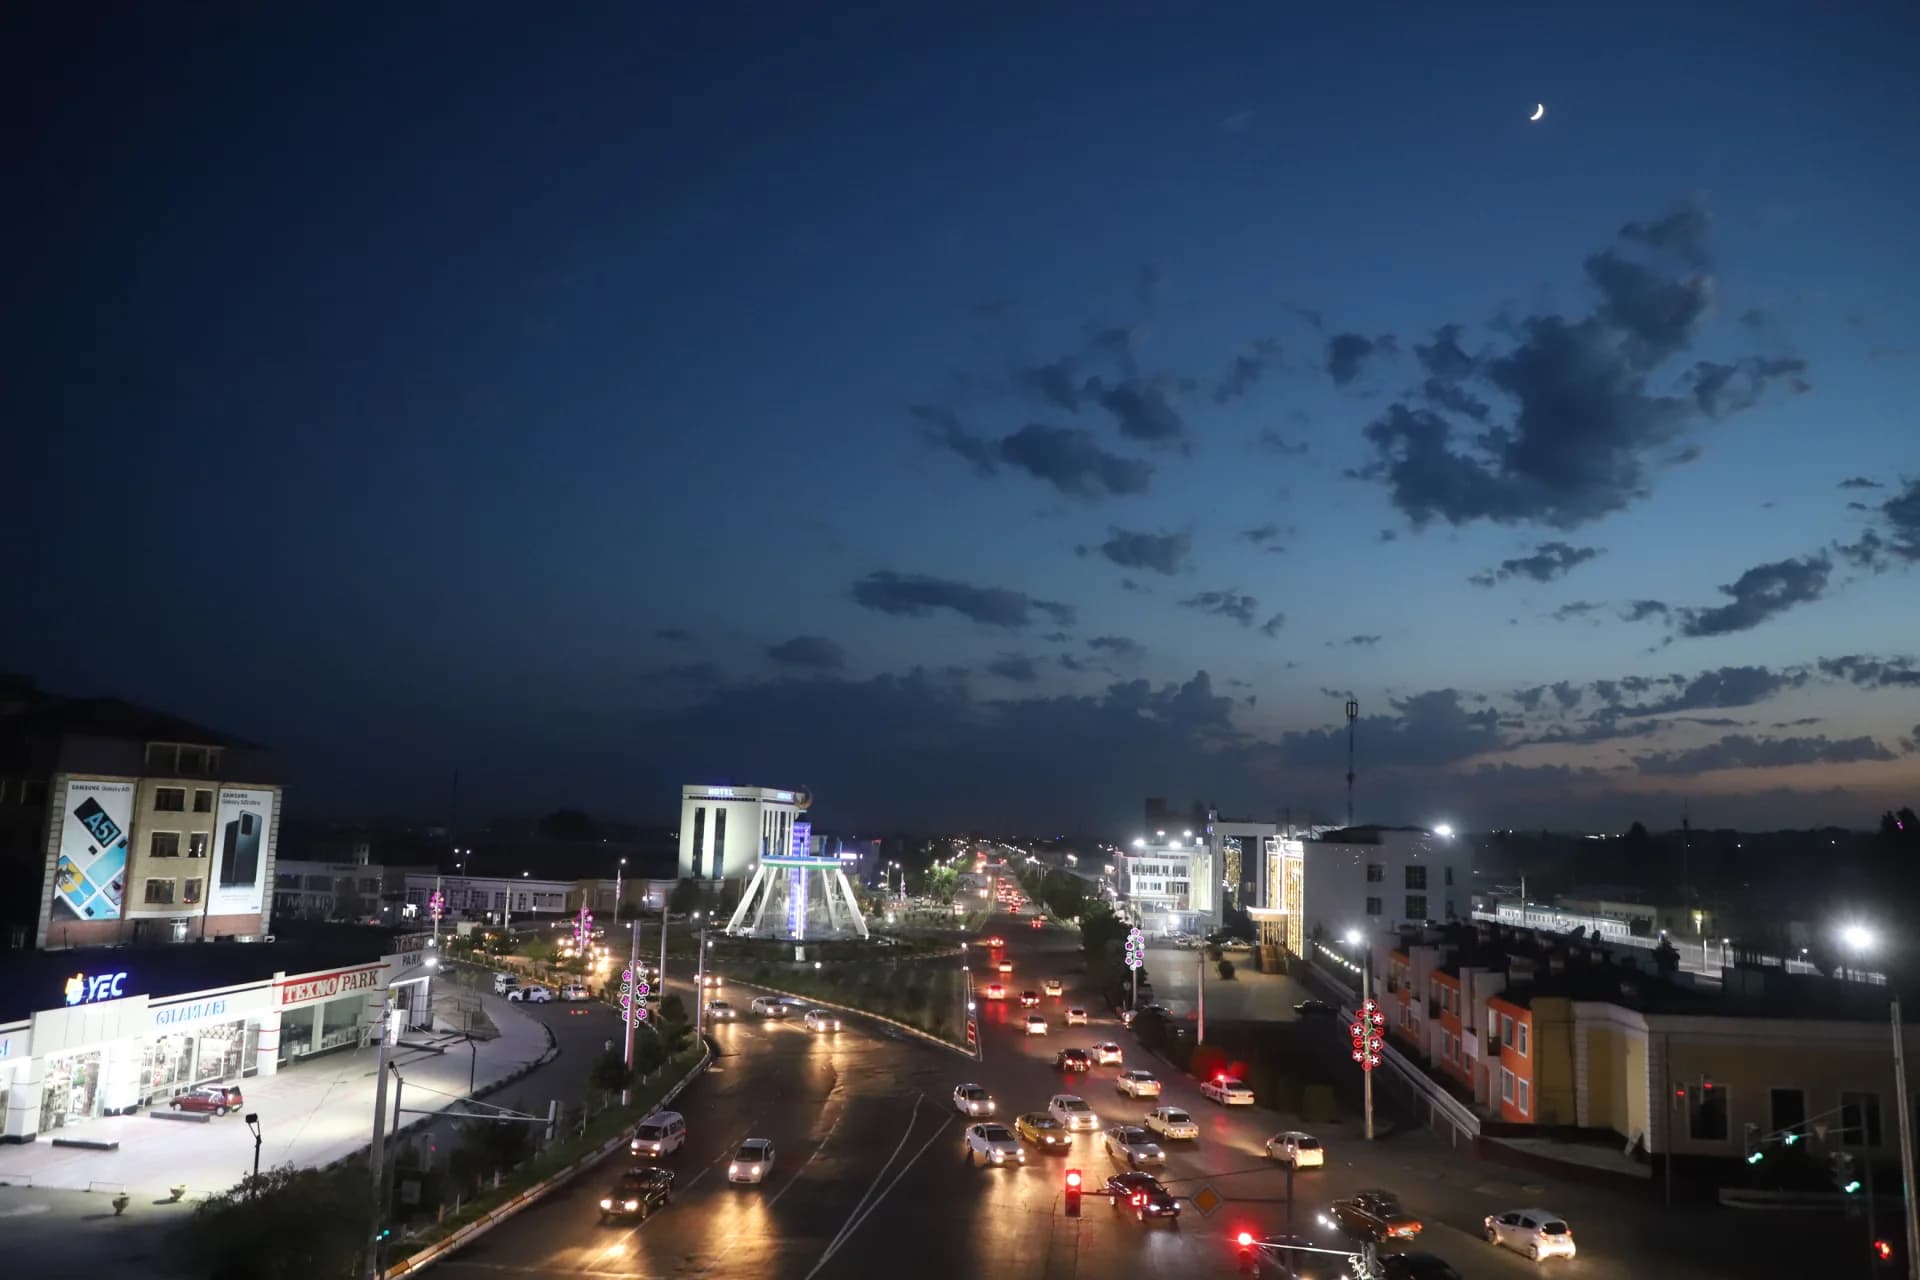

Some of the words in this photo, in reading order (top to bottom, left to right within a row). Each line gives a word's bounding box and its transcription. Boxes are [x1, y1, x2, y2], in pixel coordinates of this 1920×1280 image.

[84, 810, 120, 846] A51
[88, 972, 128, 1000] YEC
[284, 978, 337, 1002] TEXNO
[341, 970, 379, 992] PARK
